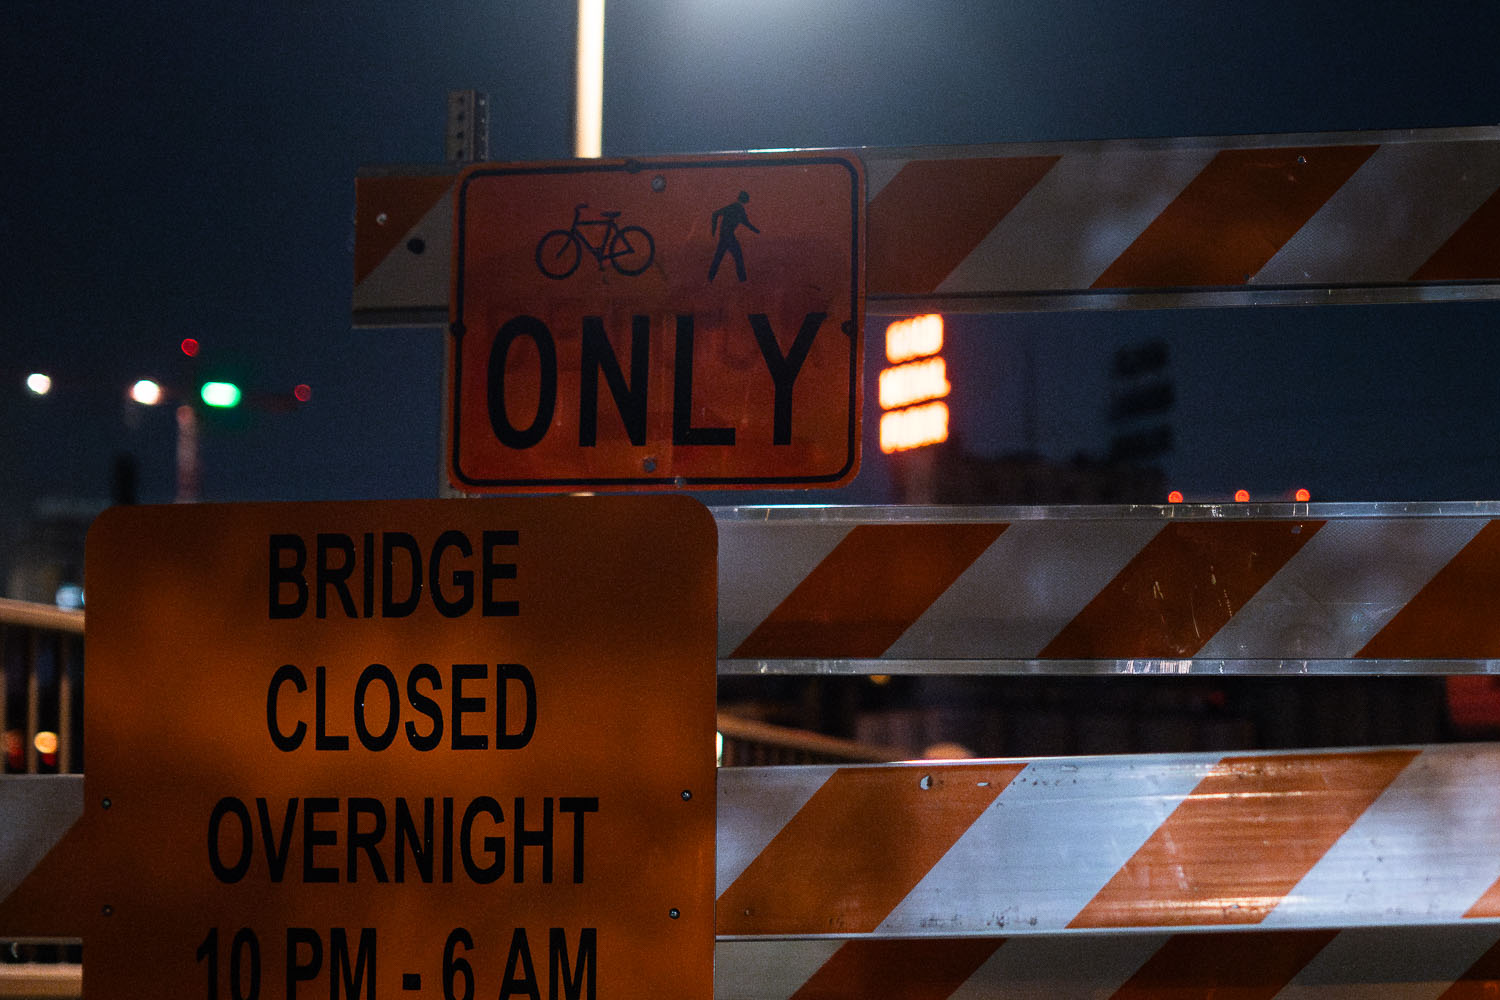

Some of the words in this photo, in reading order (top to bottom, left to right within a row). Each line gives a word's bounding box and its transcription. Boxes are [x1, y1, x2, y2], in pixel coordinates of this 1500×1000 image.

[487, 311, 828, 450] ONLY
[268, 530, 521, 620] BRIDGE
[266, 664, 538, 752] CLOSED
[207, 797, 600, 884] OVERNIGHT
[401, 973, 422, 991] -
